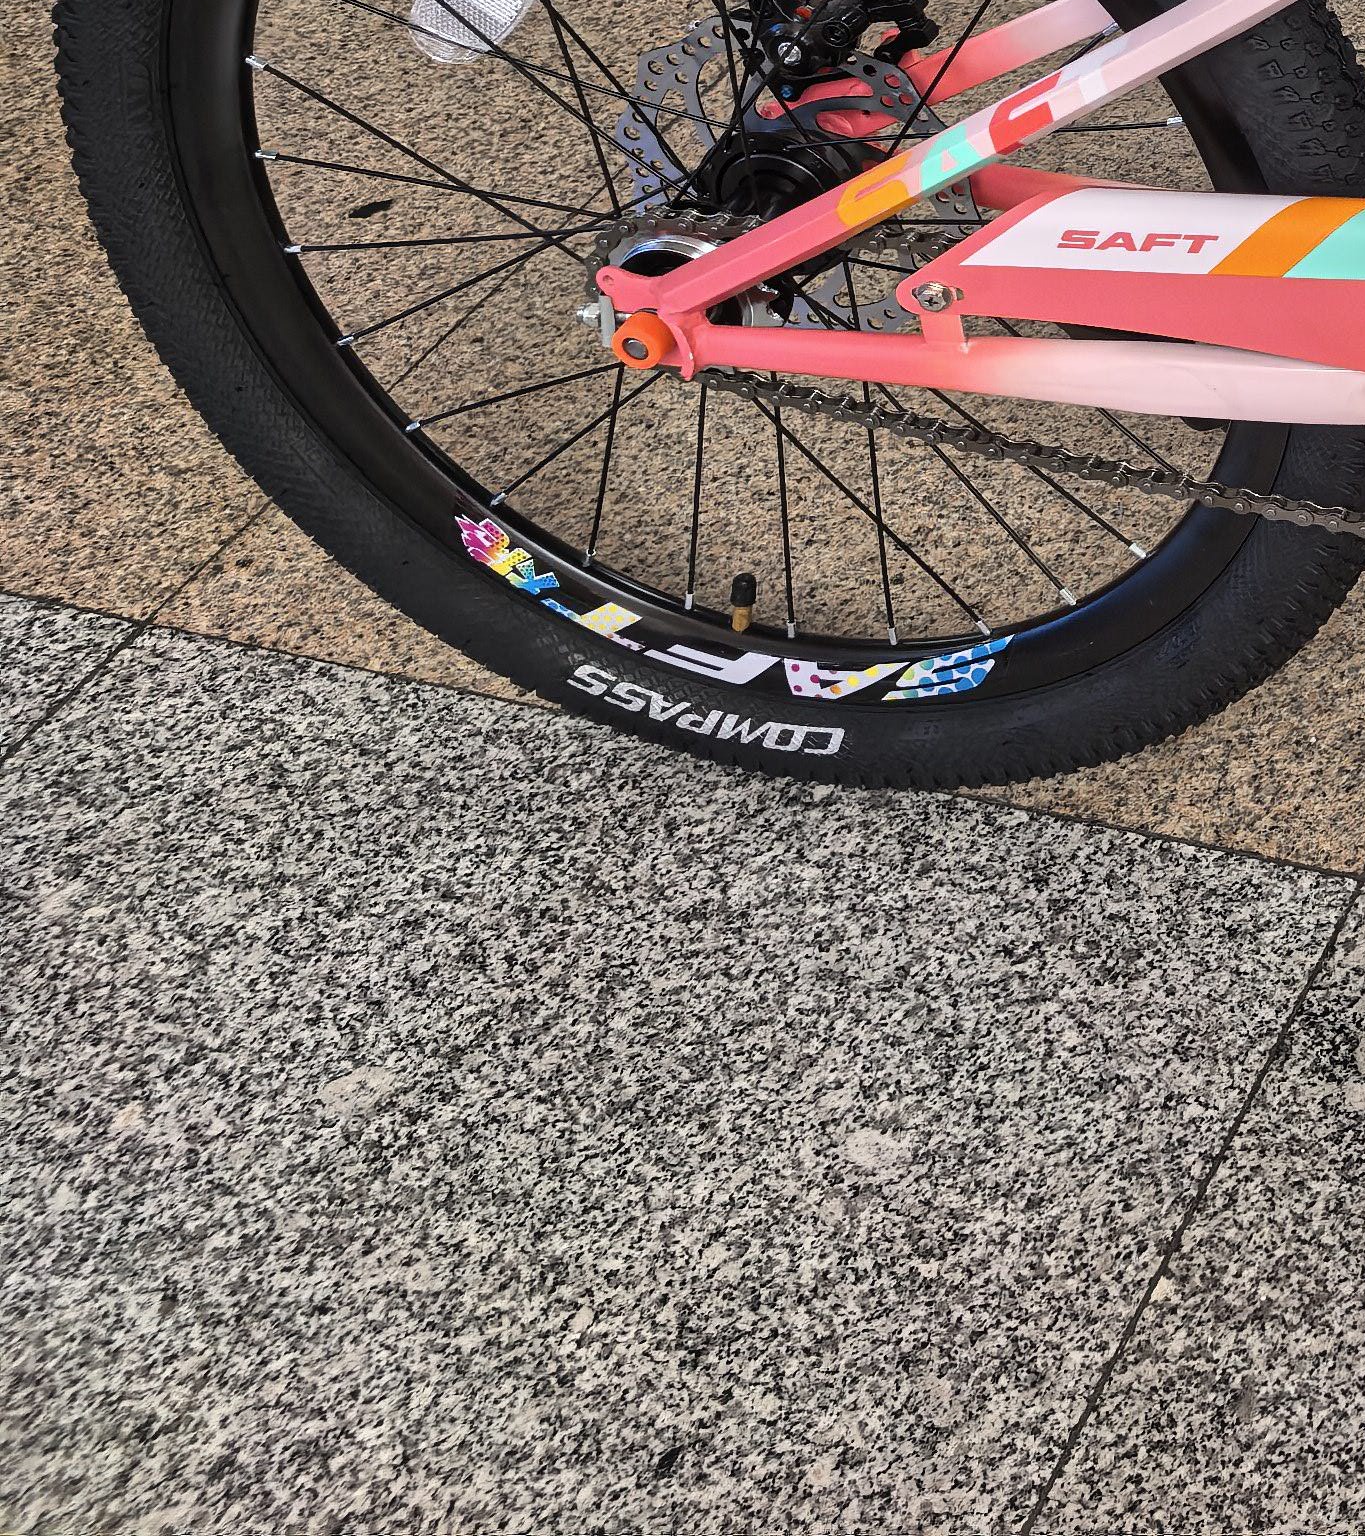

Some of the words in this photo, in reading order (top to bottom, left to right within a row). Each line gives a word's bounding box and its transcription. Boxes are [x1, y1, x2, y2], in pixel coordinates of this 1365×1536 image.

[1057, 229, 1220, 255] SAFT
[540, 598, 1017, 701] SAFT
[567, 664, 846, 757] COMPASS
